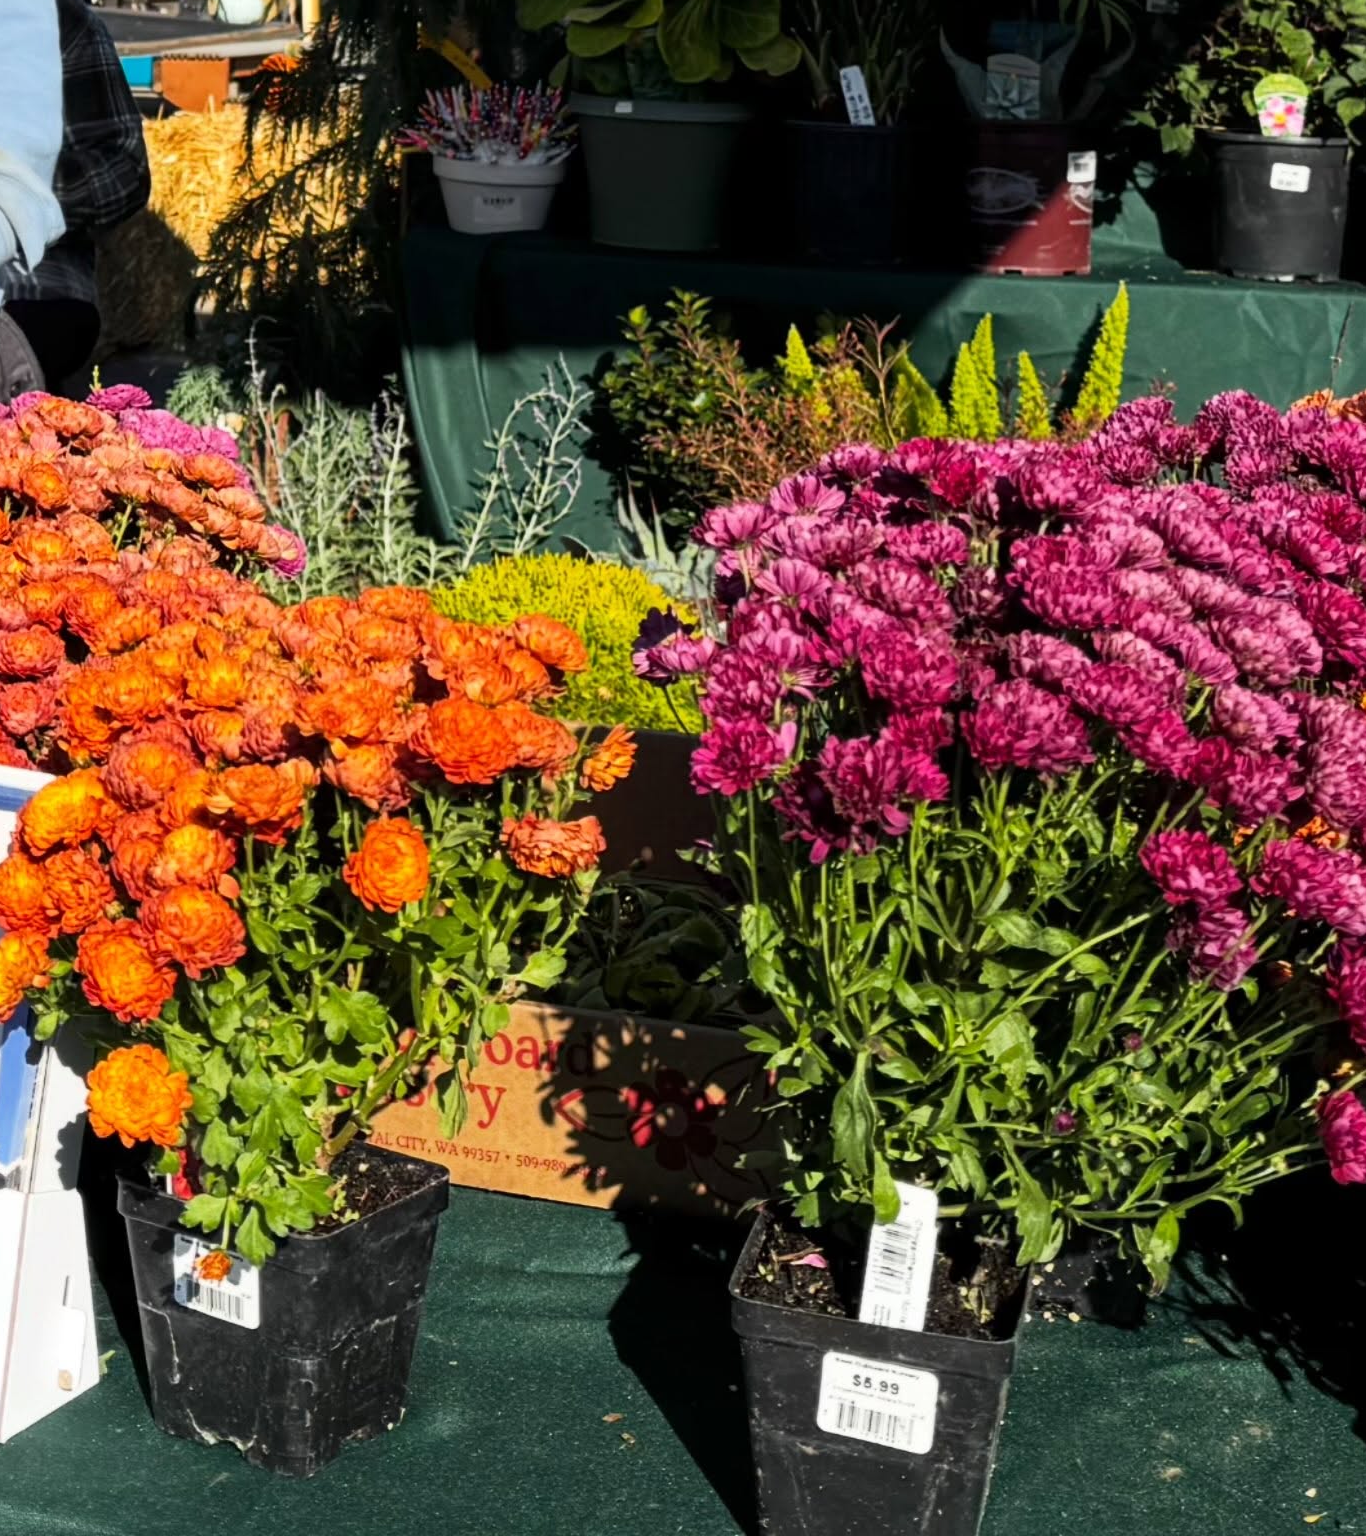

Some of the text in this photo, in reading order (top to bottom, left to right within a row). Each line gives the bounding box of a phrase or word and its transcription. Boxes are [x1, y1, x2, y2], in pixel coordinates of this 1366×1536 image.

[395, 1135, 432, 1155] CITY,
[434, 1139, 459, 1157] WA
[462, 1144, 502, 1164] 99357
